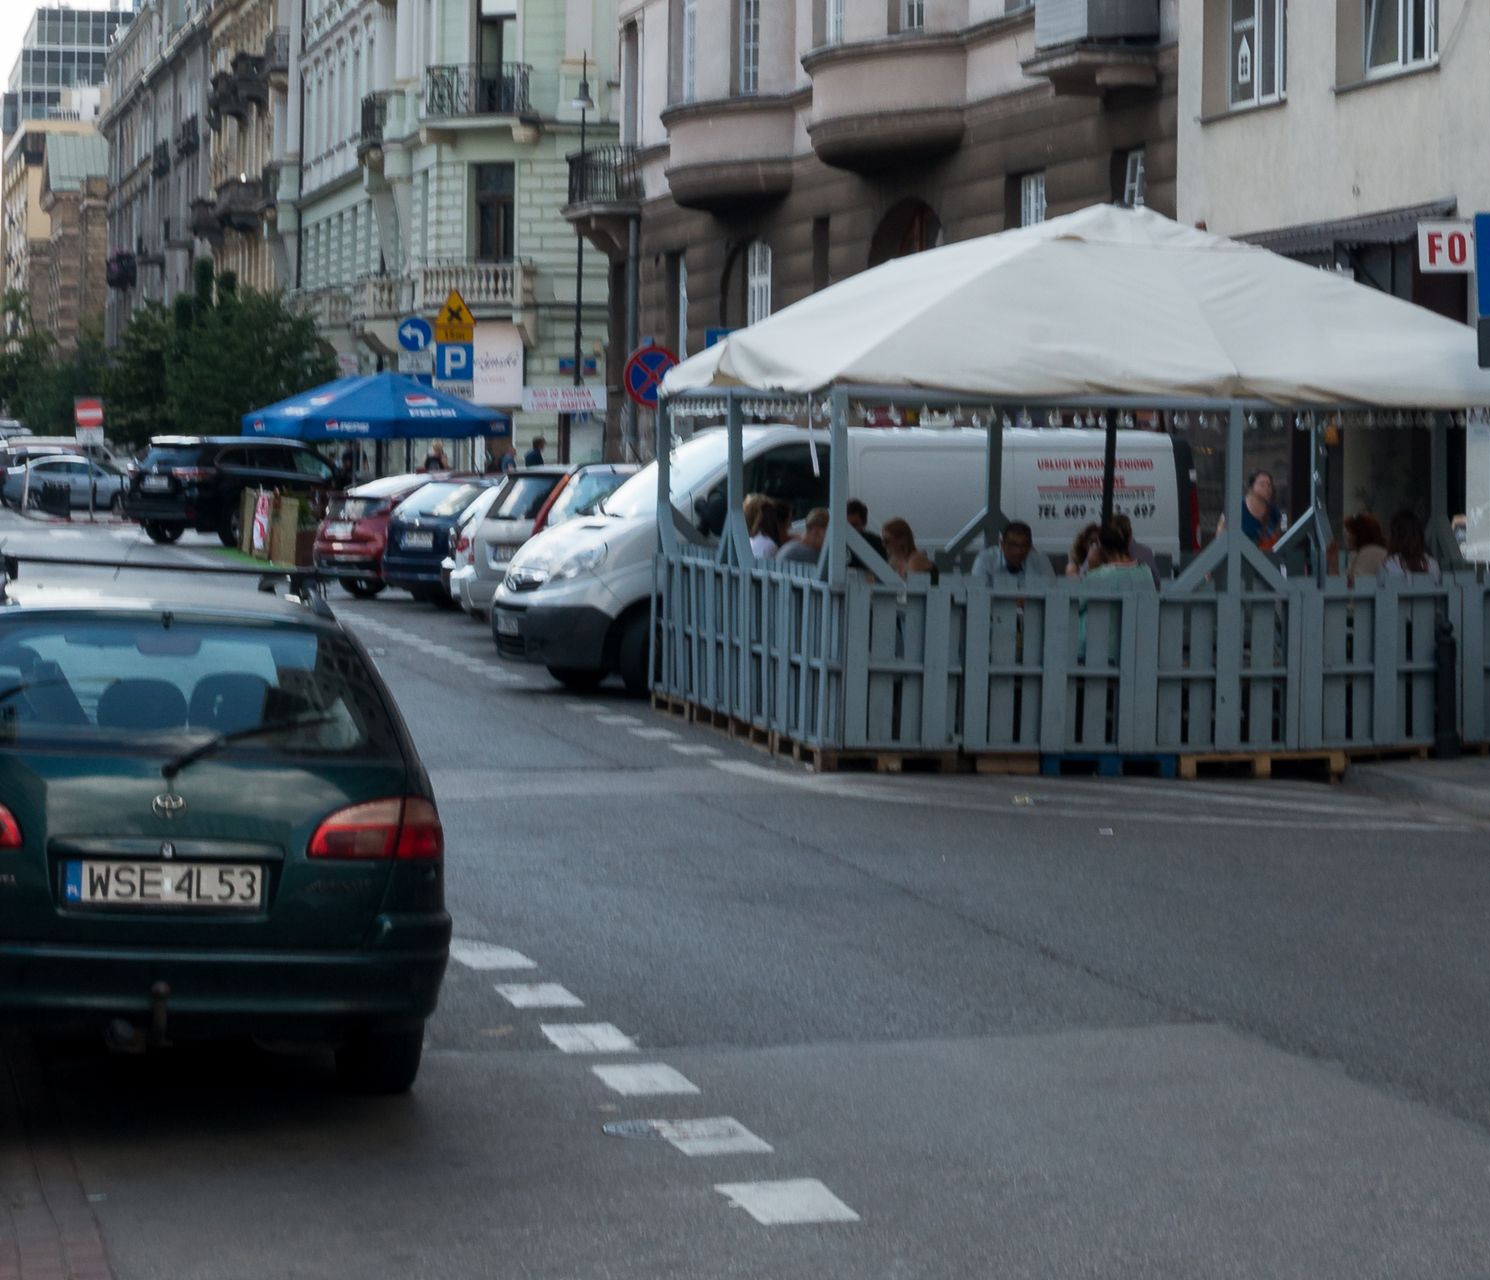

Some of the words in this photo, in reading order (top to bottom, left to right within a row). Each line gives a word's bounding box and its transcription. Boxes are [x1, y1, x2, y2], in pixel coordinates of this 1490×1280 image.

[1427, 230, 1475, 266] FO
[444, 346, 466, 378] P
[87, 866, 164, 900] WSE
[174, 867, 258, 903] 4L53
